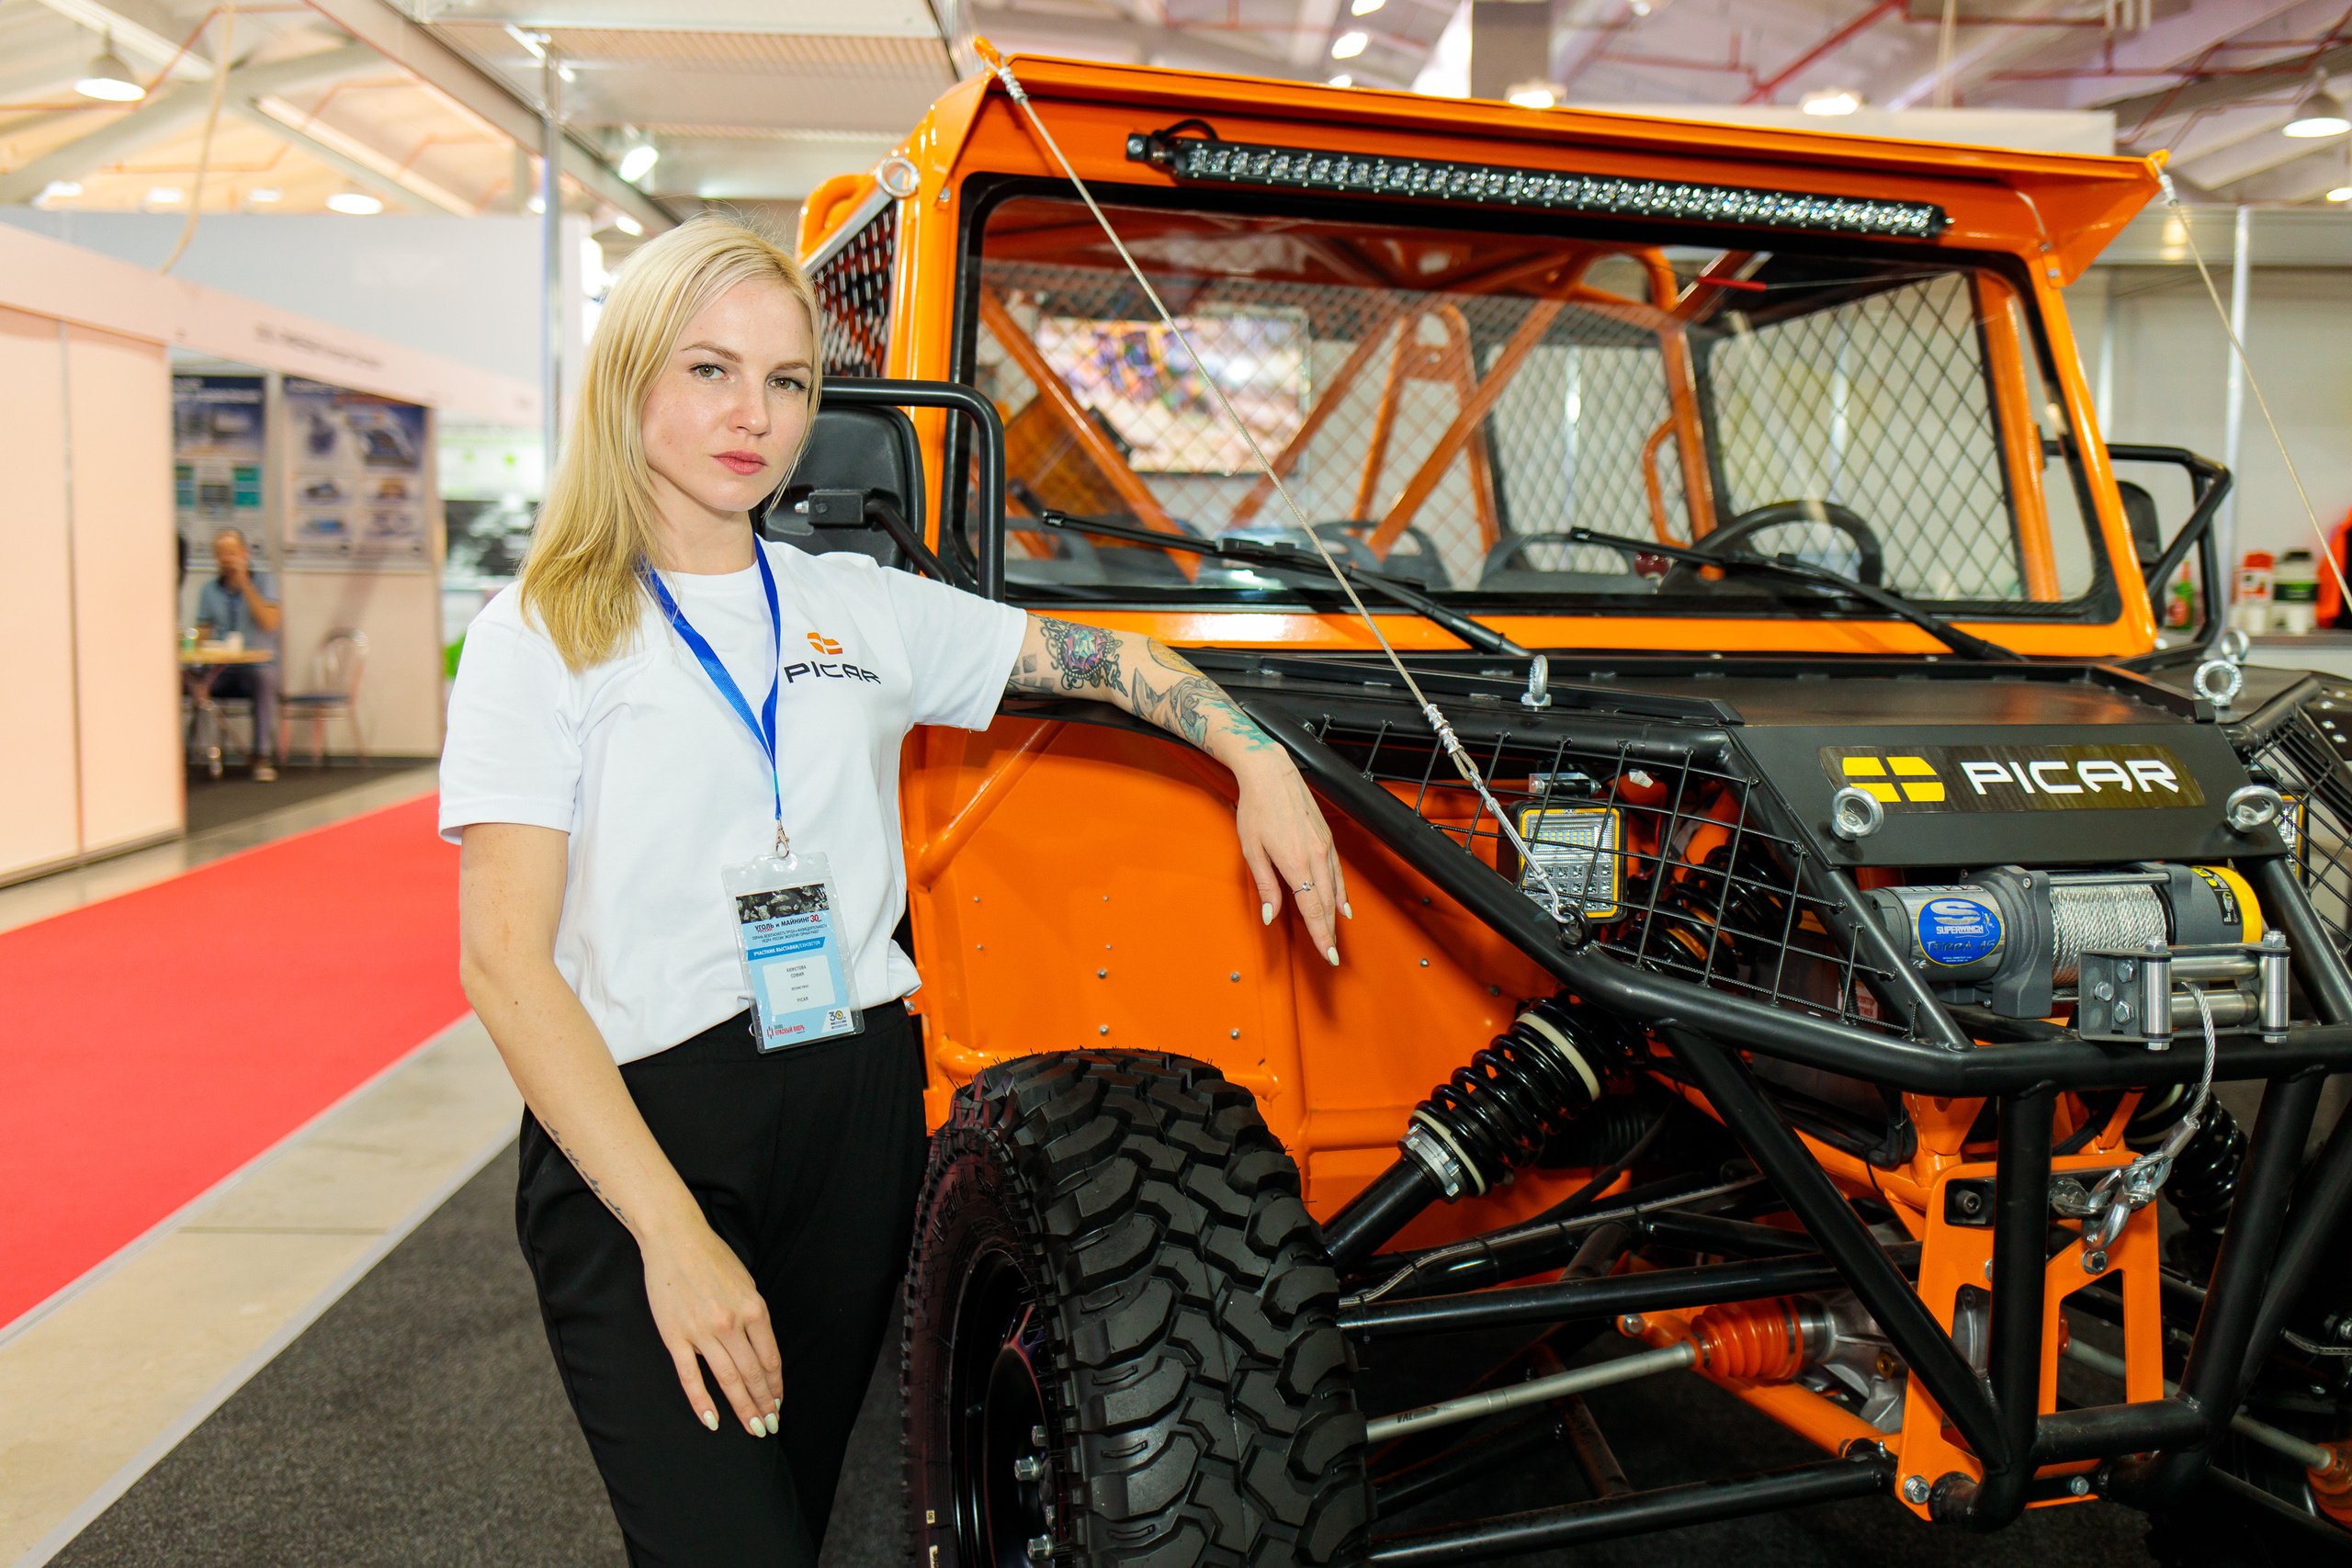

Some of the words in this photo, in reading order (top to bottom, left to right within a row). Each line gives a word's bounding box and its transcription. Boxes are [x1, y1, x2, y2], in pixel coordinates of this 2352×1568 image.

[784, 660, 882, 685] PICAR
[1960, 760, 2180, 795] PICAR
[754, 922, 775, 931] УГОЛЬ
[781, 917, 809, 927] МАЙНИНГ
[810, 914, 820, 922] 30
[1936, 925, 1984, 935] SUPERWINCH
[1926, 941, 1973, 953] TERRA
[1977, 939, 1996, 952] 45
